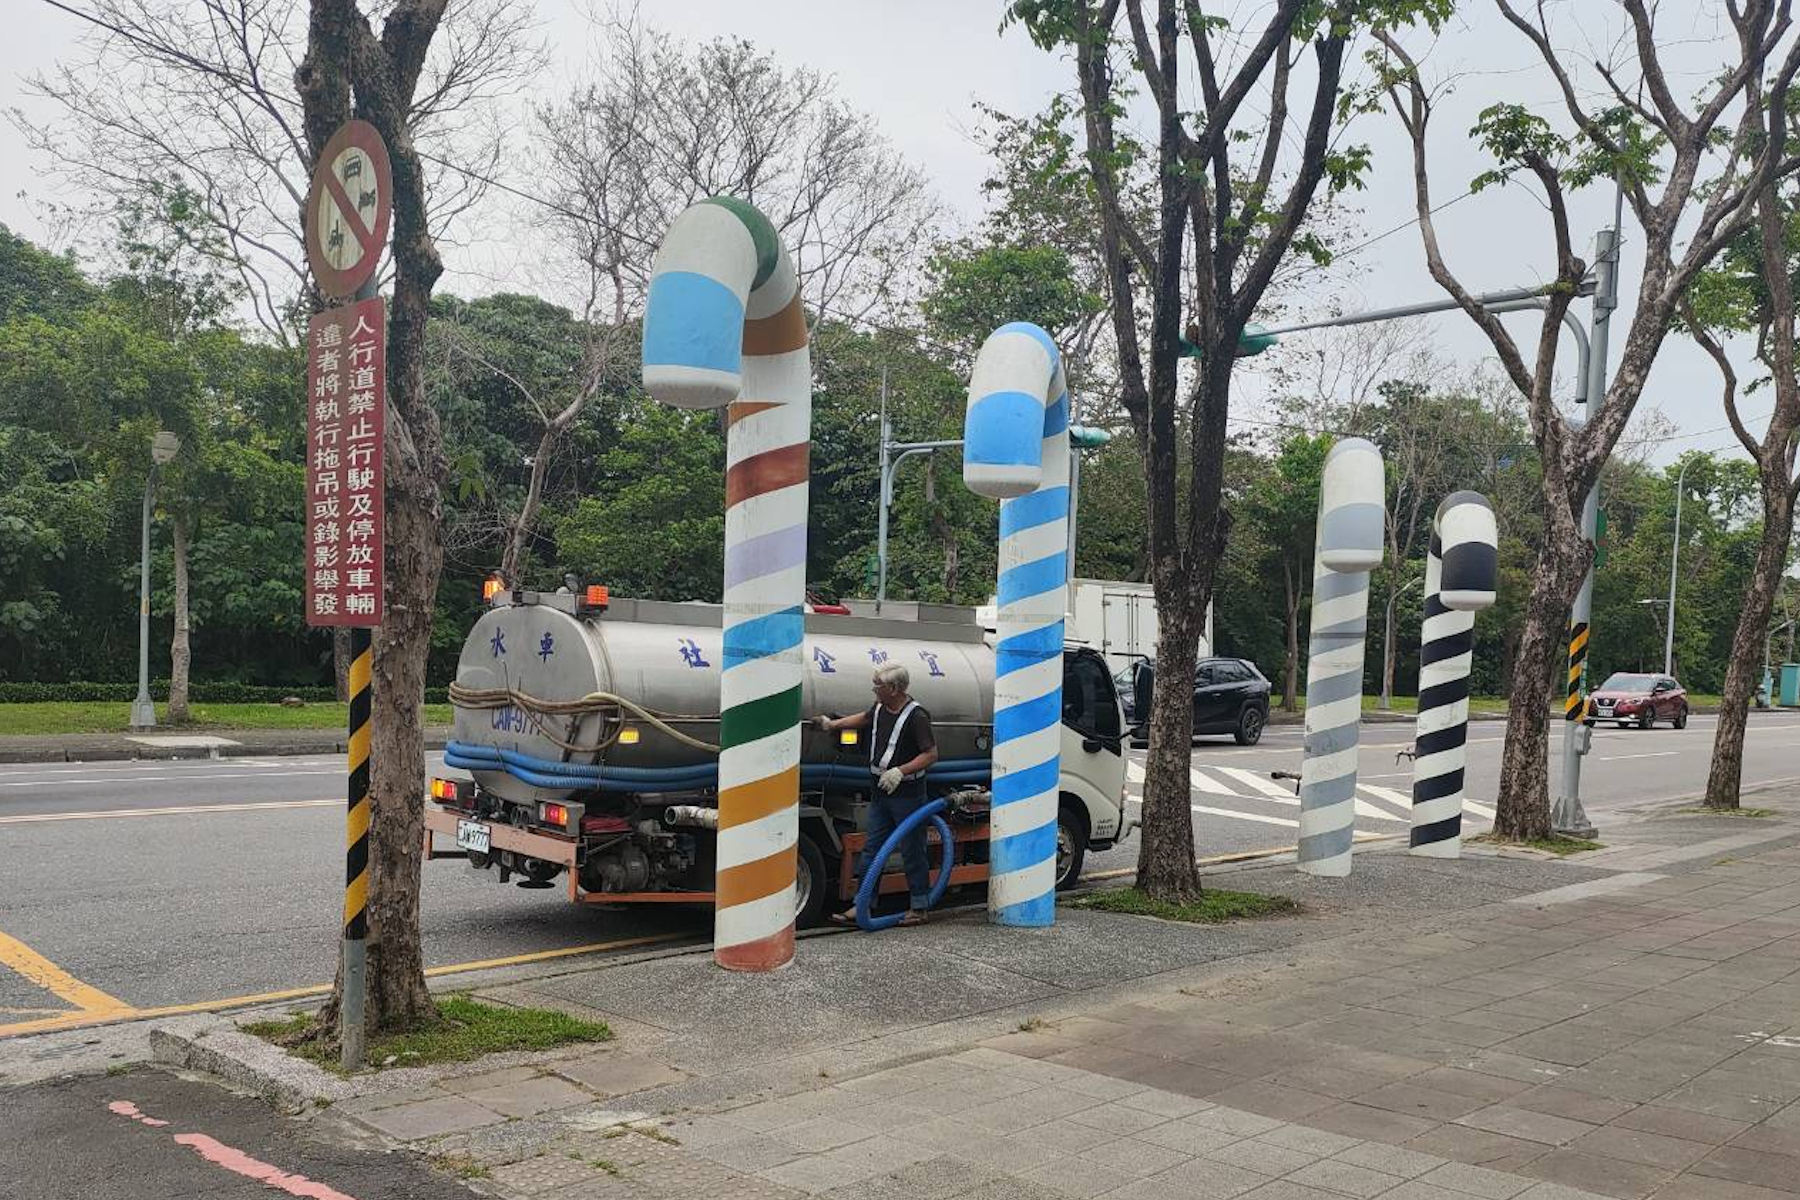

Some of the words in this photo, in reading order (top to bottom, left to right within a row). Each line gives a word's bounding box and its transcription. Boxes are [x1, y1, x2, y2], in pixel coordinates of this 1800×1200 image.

[312, 323, 342, 616] 違者將執行拖吊或錄影舉發
[345, 314, 376, 616] 人行道禁止行駛及停放車輛
